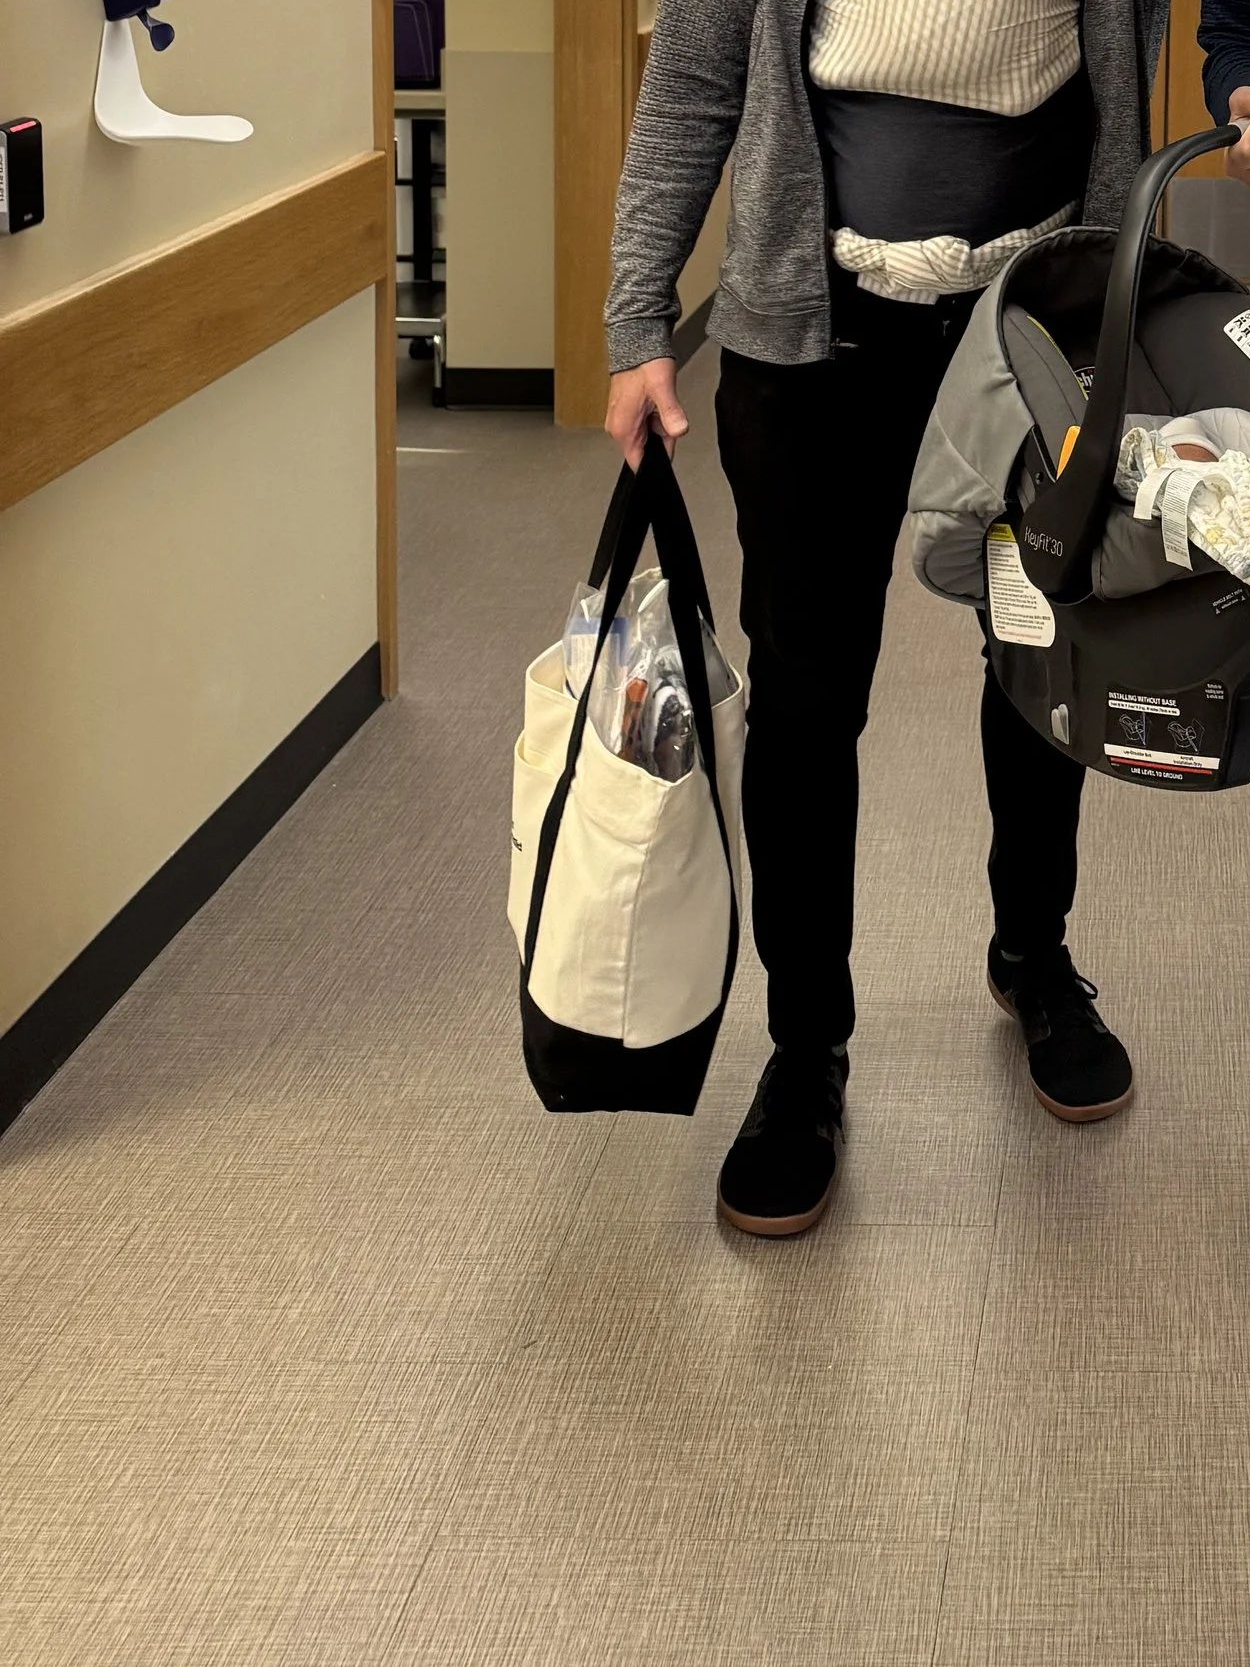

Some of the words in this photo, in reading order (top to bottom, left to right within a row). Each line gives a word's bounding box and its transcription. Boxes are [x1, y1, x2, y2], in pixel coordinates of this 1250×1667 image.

[1024, 525, 1050, 551] KeyFit
[1050, 538, 1063, 557] 30
[1108, 691, 1137, 702] INSTALLING
[1137, 695, 1161, 705] WITHOUT
[1161, 698, 1177, 707] BASE
[1141, 768, 1156, 776] LEVEL
[1163, 772, 1183, 780] GROUND
